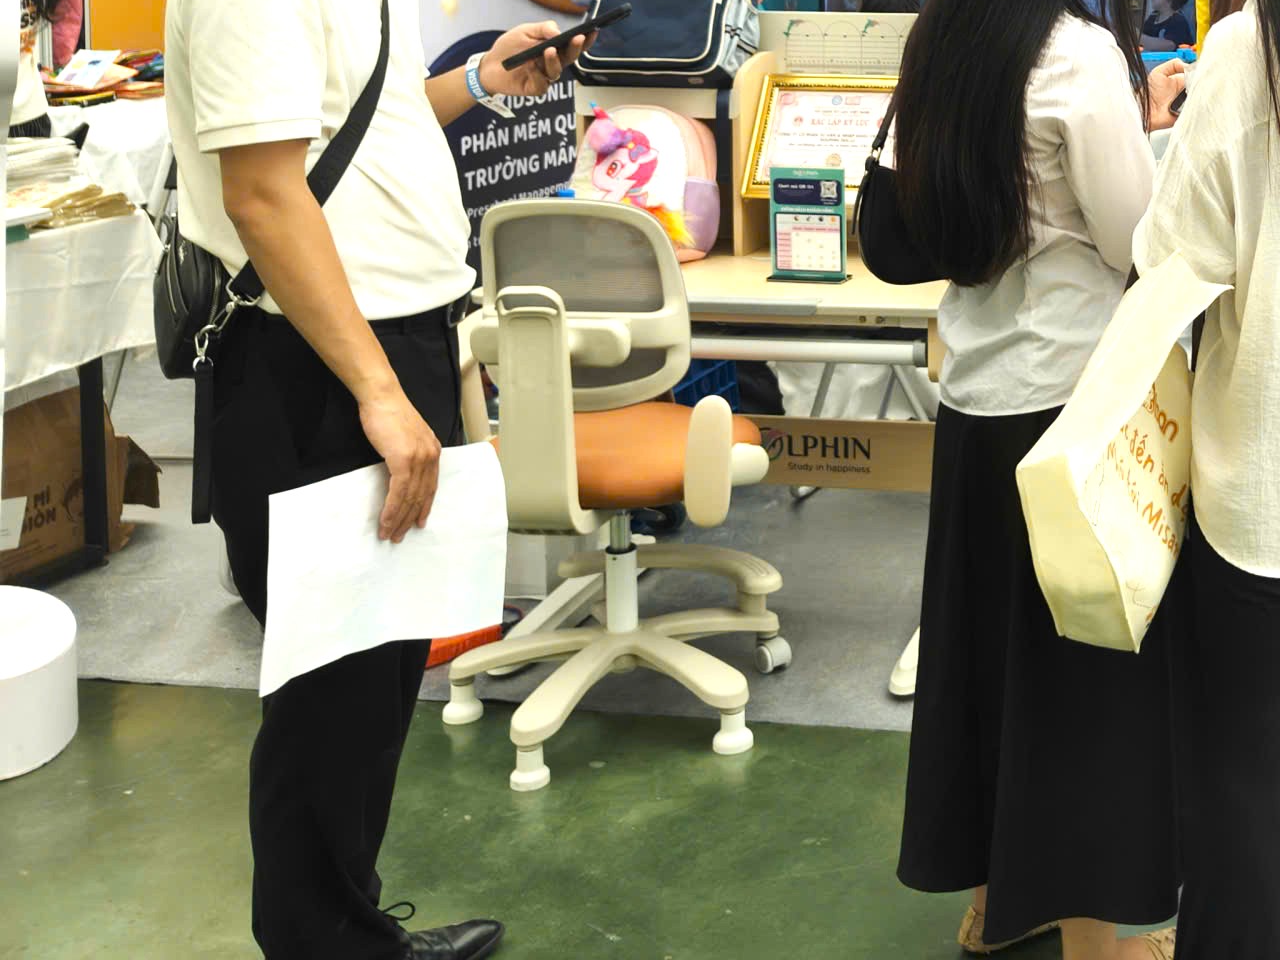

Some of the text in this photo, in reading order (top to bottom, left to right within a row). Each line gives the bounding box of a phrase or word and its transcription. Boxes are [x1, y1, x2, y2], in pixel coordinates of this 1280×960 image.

[461, 110, 551, 156] PHẦN MỀM
[465, 155, 540, 191] TRƯỜNG
[788, 462, 870, 473] Study in happiness
